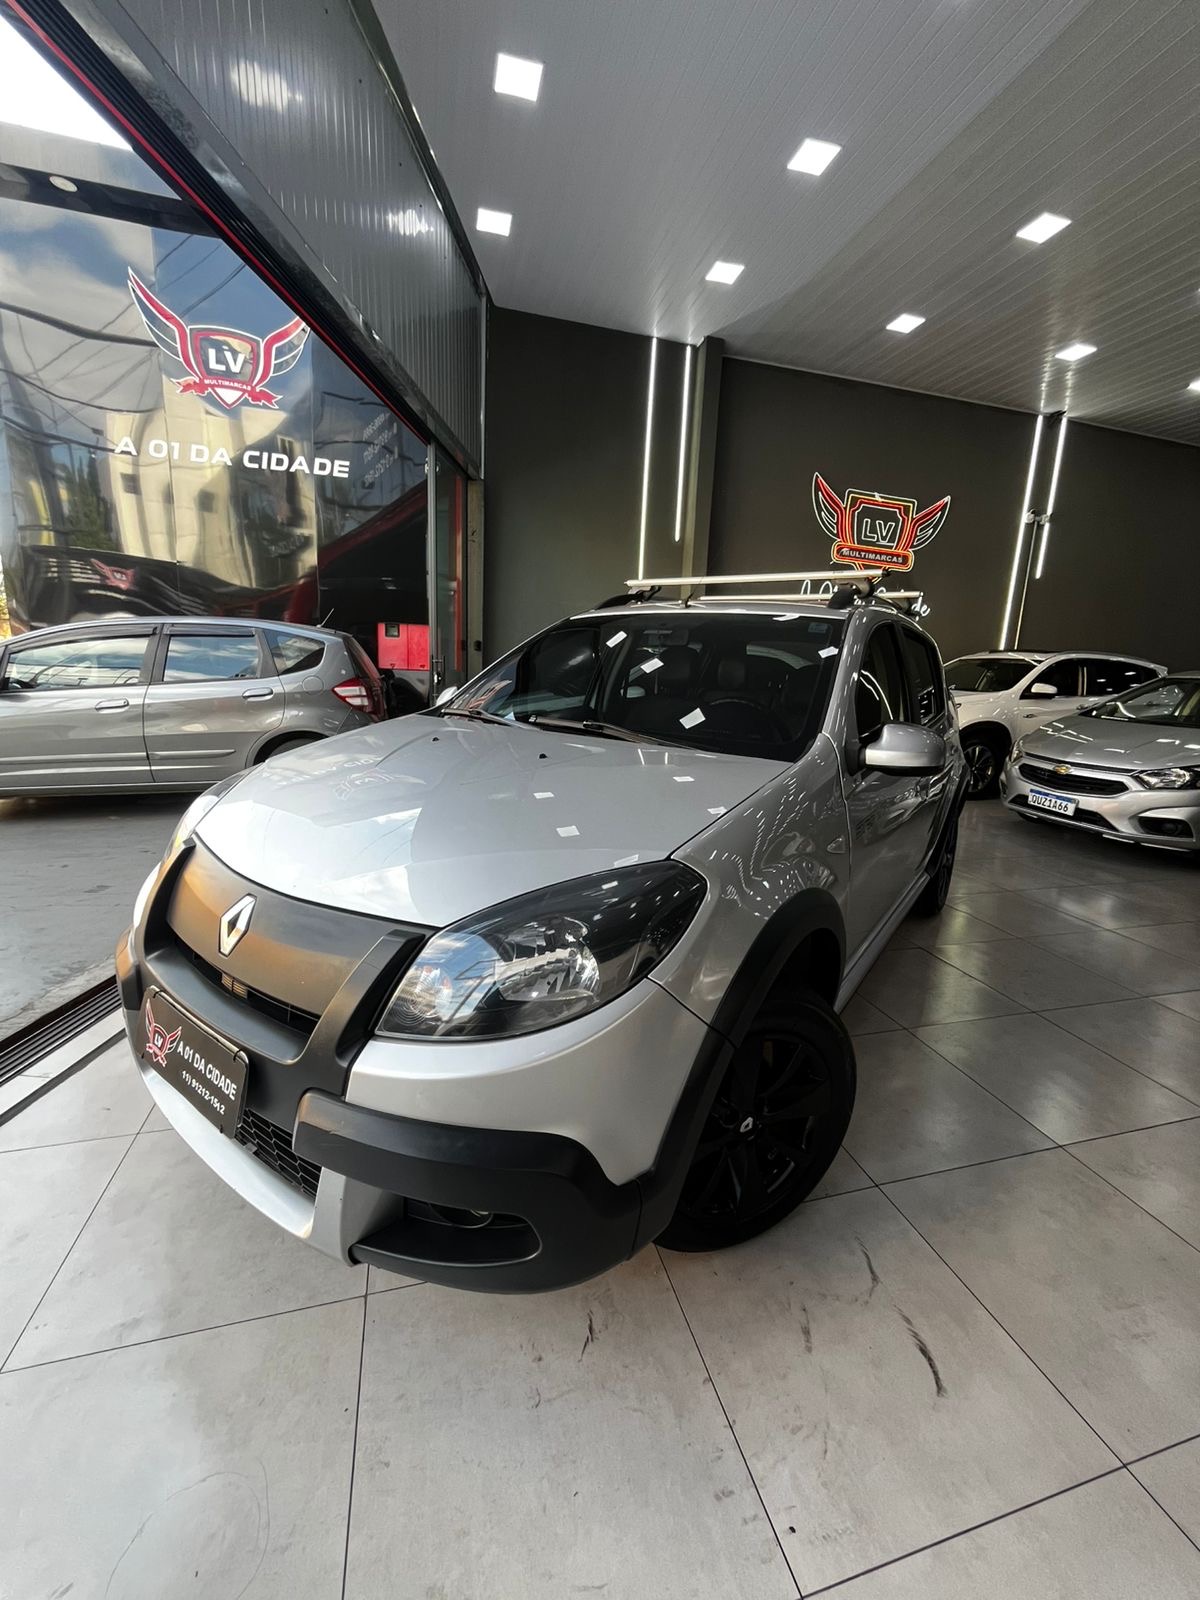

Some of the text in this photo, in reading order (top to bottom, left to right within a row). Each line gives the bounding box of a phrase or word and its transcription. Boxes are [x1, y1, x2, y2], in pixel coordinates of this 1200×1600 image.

[208, 348, 245, 373] LV
[204, 379, 251, 391] MULTIMARCAS
[114, 436, 138, 456] A
[190, 443, 232, 466] DA
[243, 450, 350, 478] CIDADE
[862, 518, 895, 543] LV
[842, 549, 903, 563] MULTIMARCAS
[154, 1033, 164, 1048] LV
[177, 1041, 237, 1101] A 01 DA CIDADE
[182, 1070, 192, 1086] 11)
